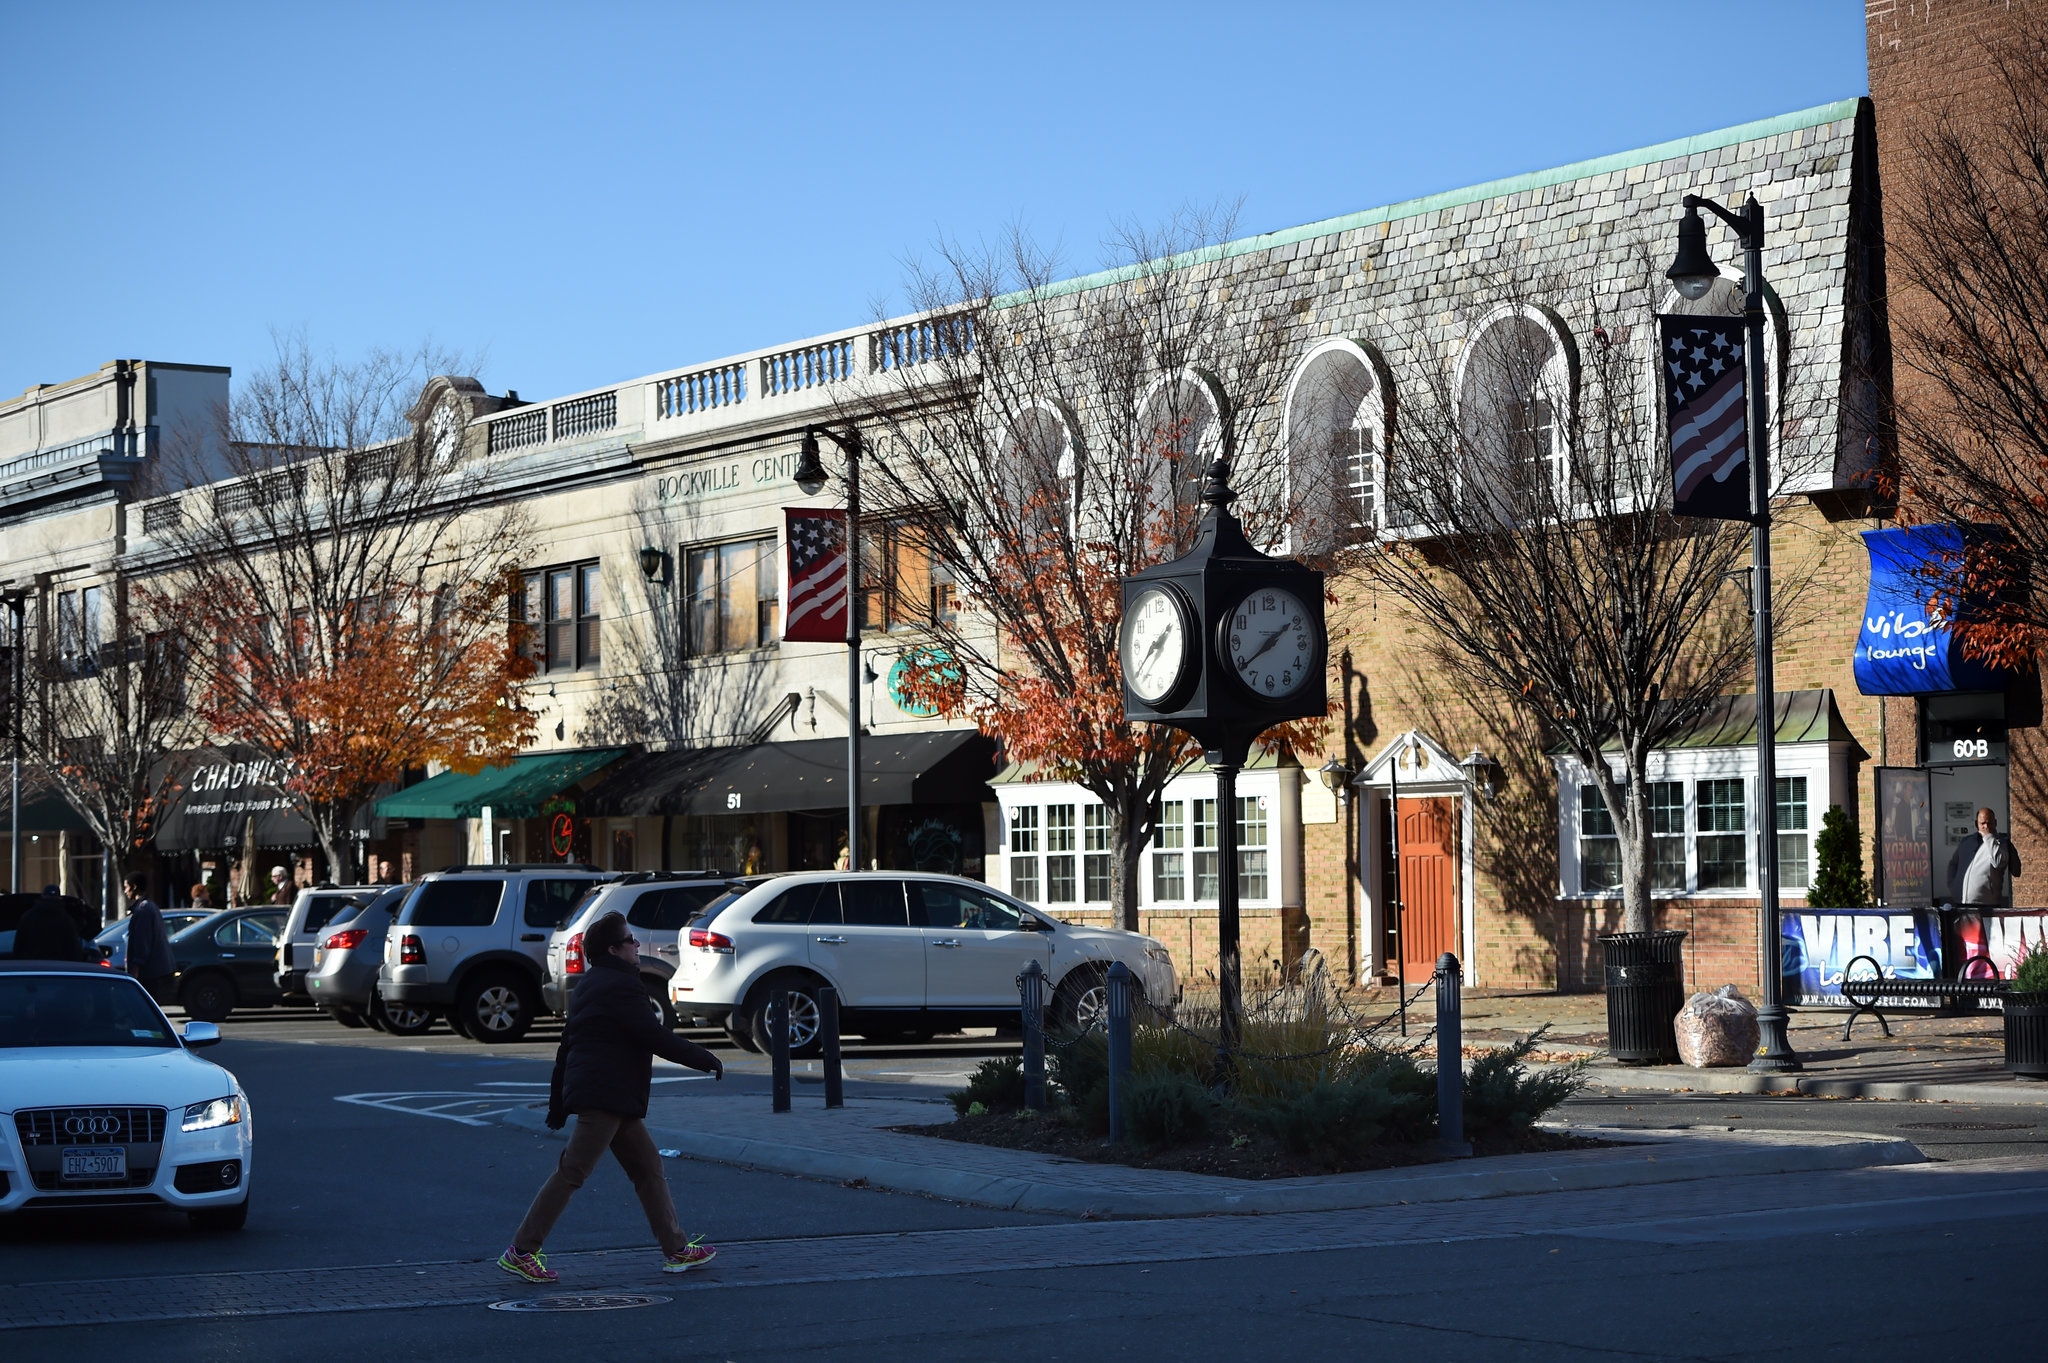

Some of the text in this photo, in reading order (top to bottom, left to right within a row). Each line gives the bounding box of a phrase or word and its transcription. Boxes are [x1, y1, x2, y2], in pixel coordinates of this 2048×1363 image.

[658, 422, 971, 500] ROCKVILLE CENT OICE BLD
[1248, 600, 1256, 615] 11
[1262, 595, 1276, 611] 12
[1236, 615, 1247, 630] 10
[1292, 615, 1302, 631] 2
[1231, 634, 1241, 651] 9
[1296, 634, 1307, 651] 3
[1292, 655, 1302, 671] 4
[1867, 645, 1936, 670] lounge
[1248, 670, 1258, 686] 7
[1265, 674, 1275, 691] 6
[1282, 670, 1291, 686] 5
[1953, 739, 1989, 758] 60-B
[185, 802, 221, 815] American
[223, 800, 244, 813] Chop
[247, 798, 270, 811] House
[726, 793, 742, 809] 51
[1800, 915, 1917, 968] VIBE
[1819, 959, 1896, 986] Loune
[1794, 994, 1928, 1008] WWW.VIBEOUNGELI.COM
[1755, 1046, 1768, 1056] 15
[68, 1156, 119, 1173] EHZ 5907
